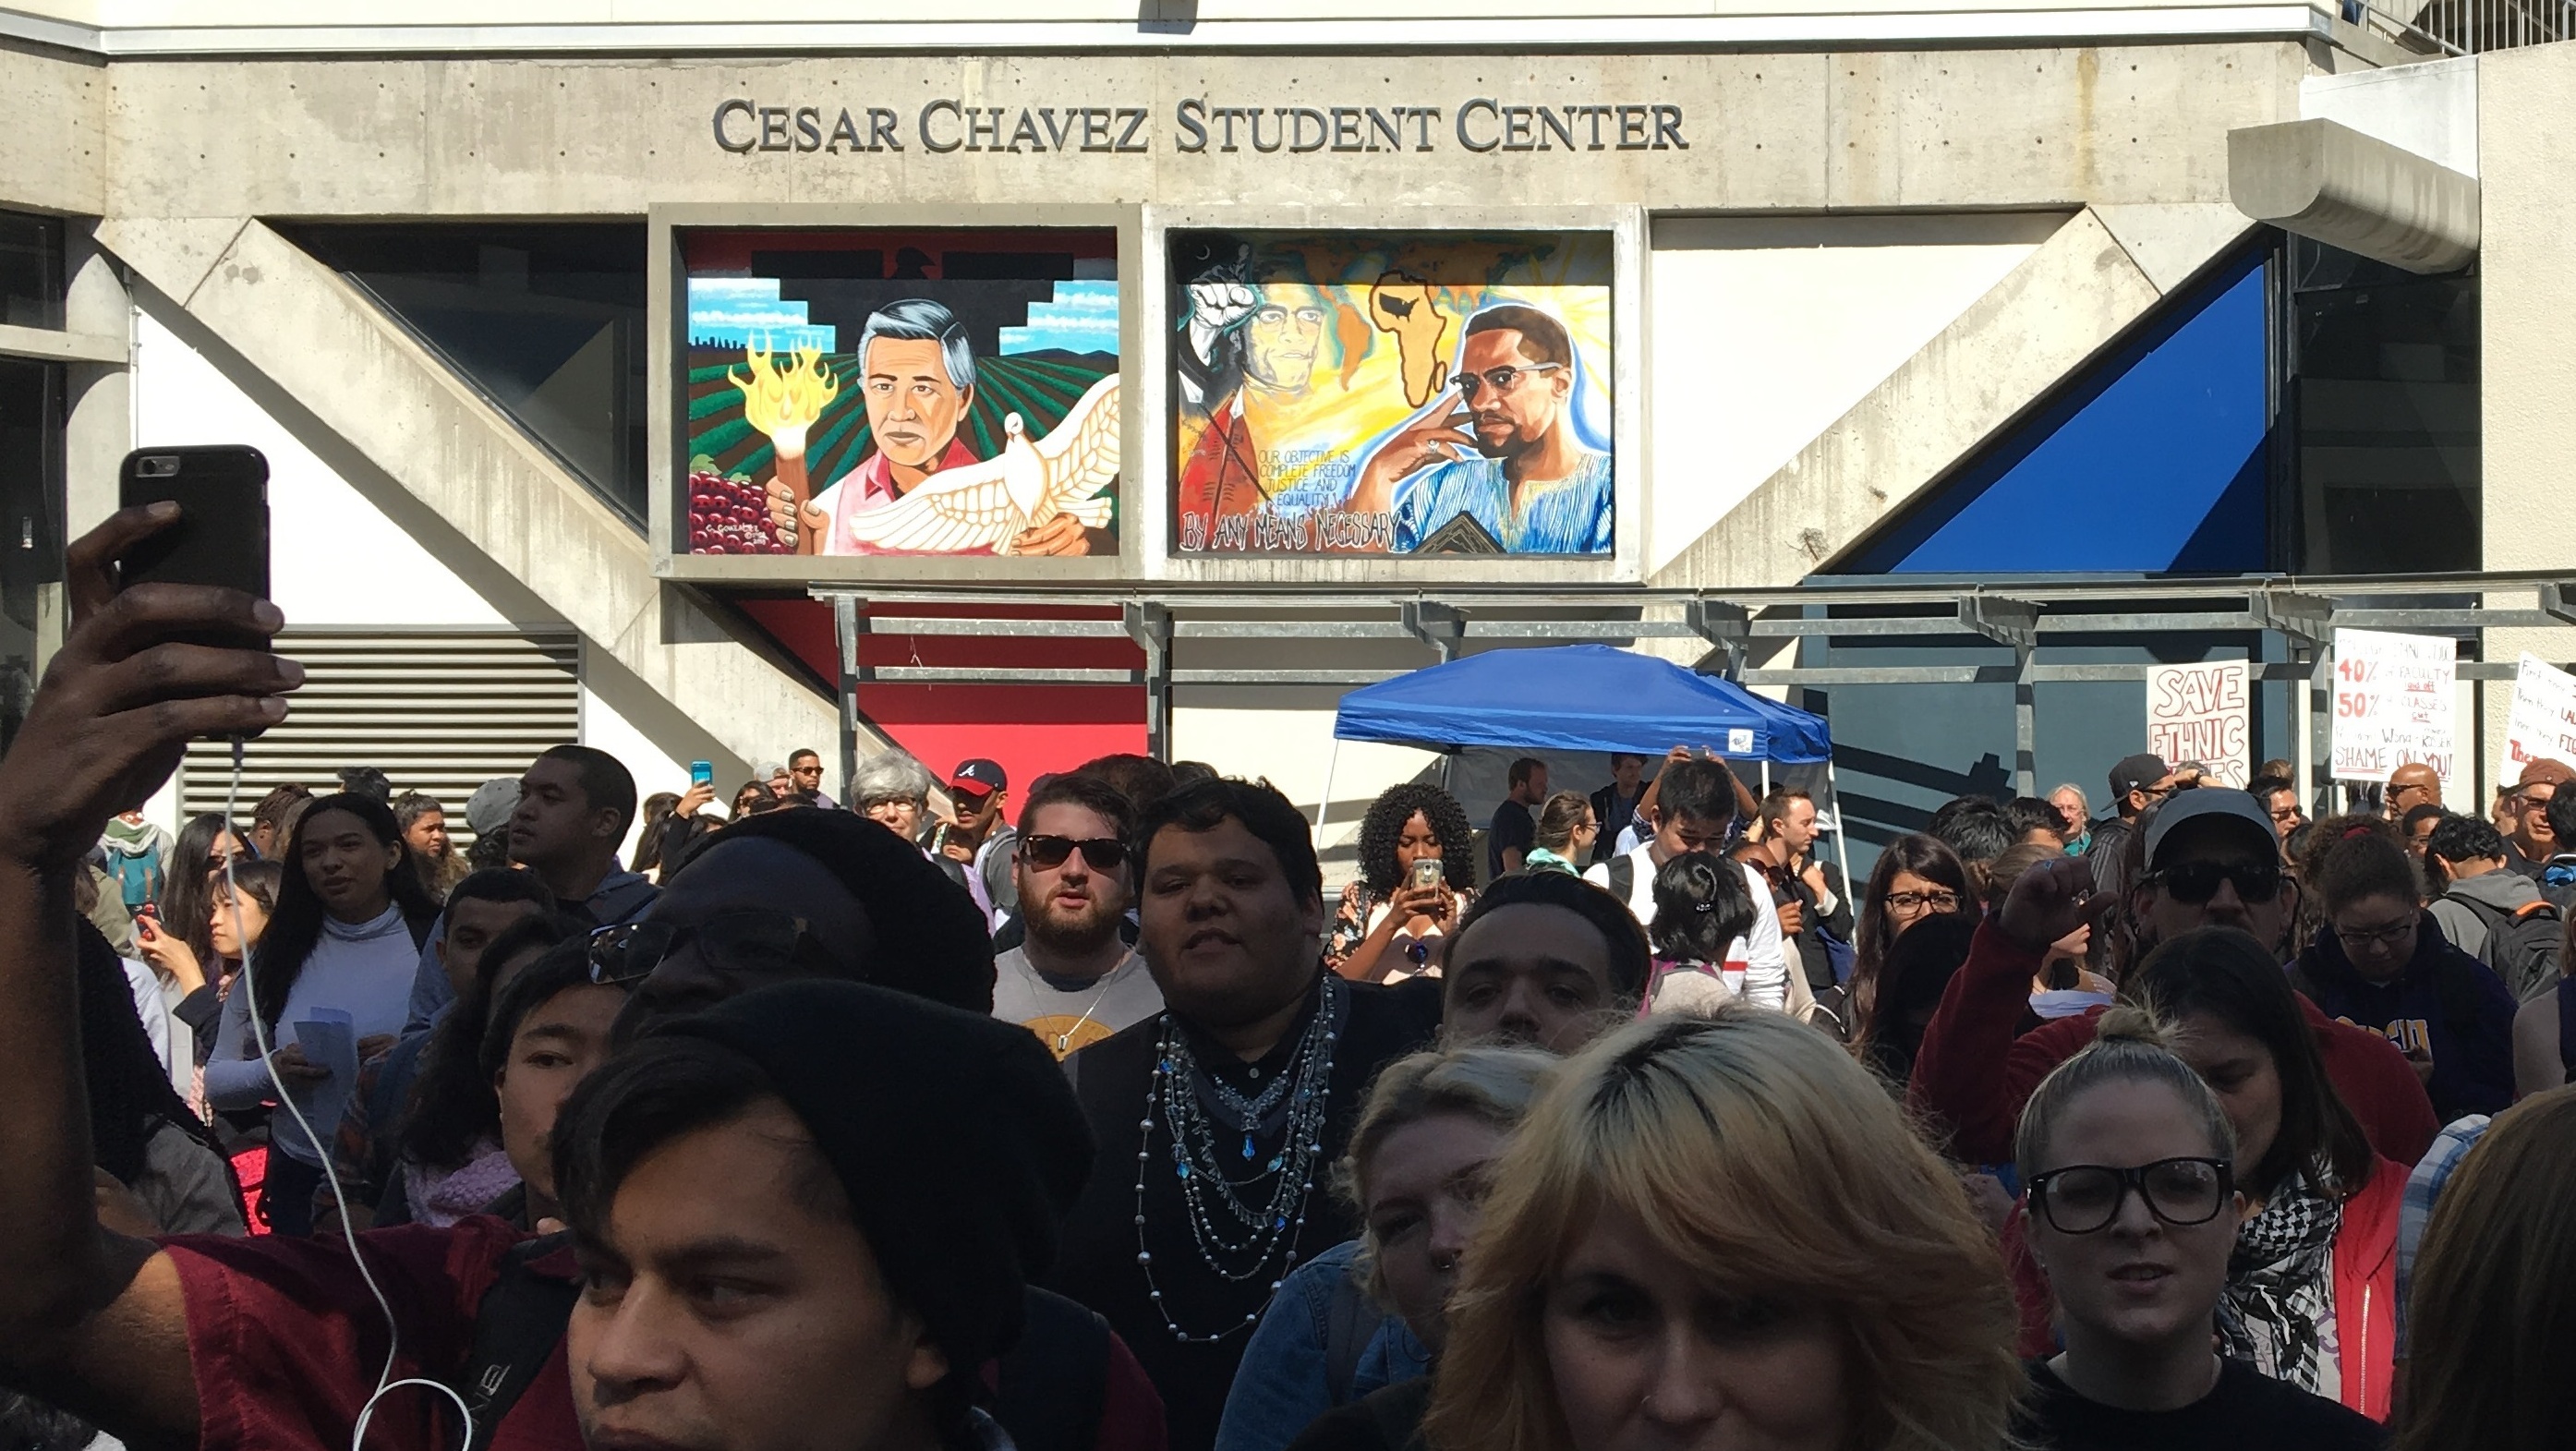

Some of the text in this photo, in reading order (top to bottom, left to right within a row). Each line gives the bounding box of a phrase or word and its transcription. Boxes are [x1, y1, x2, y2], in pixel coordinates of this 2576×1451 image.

[712, 97, 1690, 153] CESAR CHAVEZ STUDENT CENTER
[1259, 450, 1350, 464] OUR OBJECTIVE IS
[1260, 464, 1357, 478] COMPLETE FREEDOM
[1265, 478, 1337, 492] JUSTICE AND
[1180, 509, 1402, 553] BY ANY MEANS NECESSARY
[2338, 658, 2378, 683] 40%
[2400, 665, 2450, 685] FACULTY
[2154, 666, 2245, 718] SAVE
[2338, 693, 2379, 719] 50%
[2149, 716, 2245, 763] ETHNIC
[2335, 745, 2453, 780] SHAME ON YOU!
